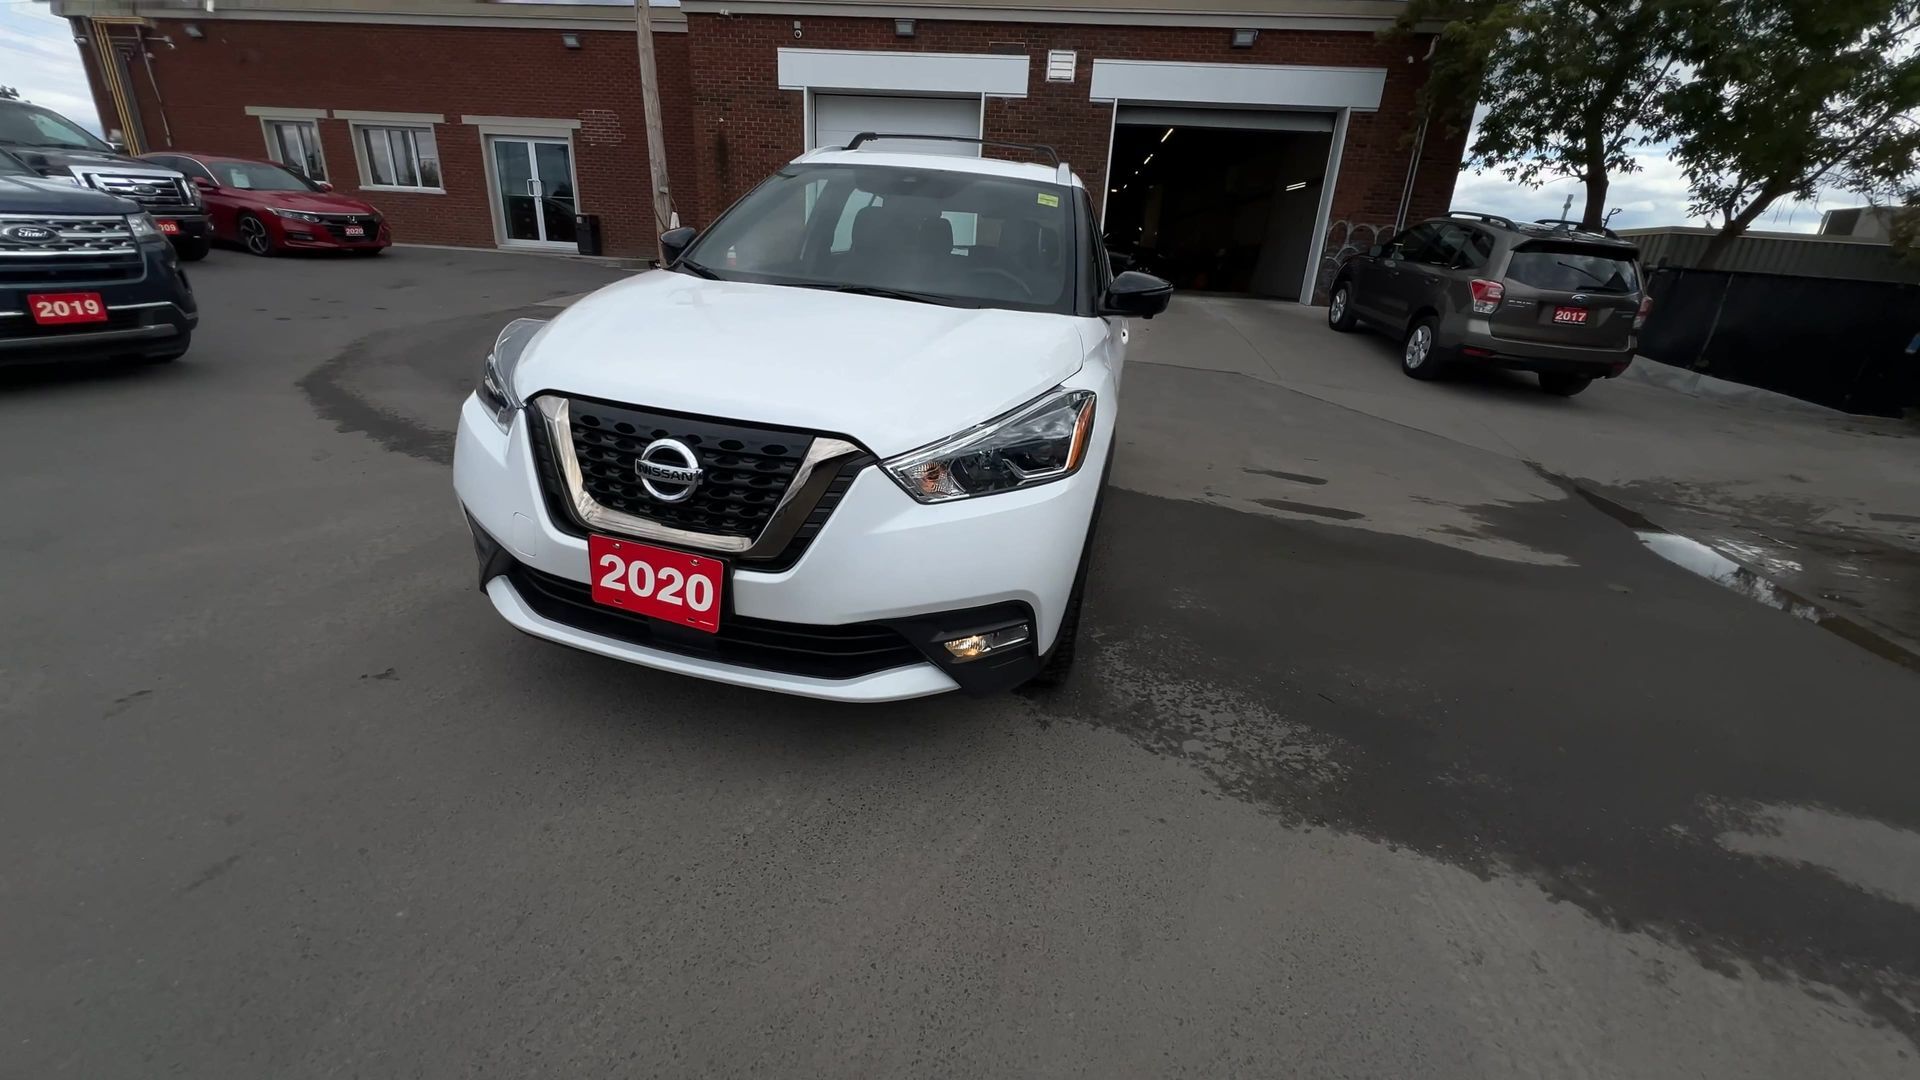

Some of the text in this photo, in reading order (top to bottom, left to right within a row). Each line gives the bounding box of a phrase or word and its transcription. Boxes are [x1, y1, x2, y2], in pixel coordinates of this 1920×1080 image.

[36, 299, 99, 317] 2019
[1554, 310, 1587, 322] 2017
[639, 463, 694, 482] NISSAN
[599, 553, 714, 612] 2020
